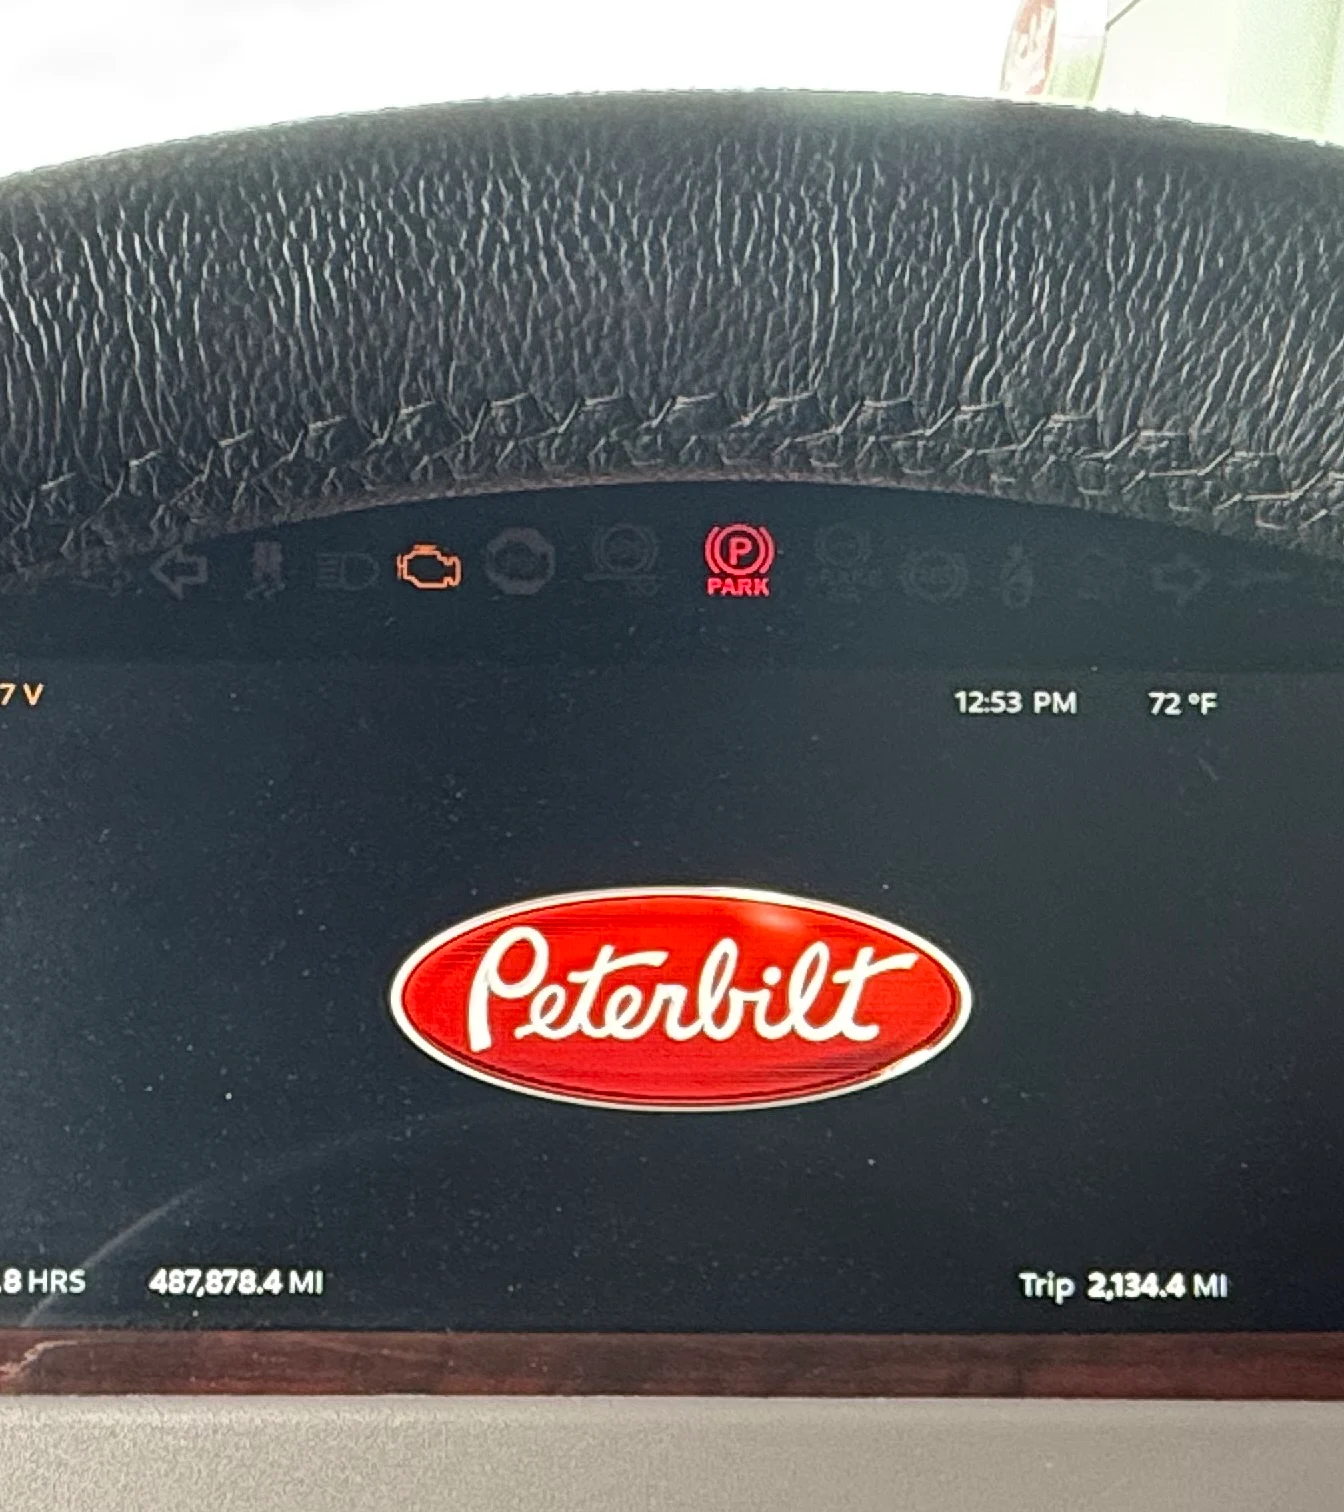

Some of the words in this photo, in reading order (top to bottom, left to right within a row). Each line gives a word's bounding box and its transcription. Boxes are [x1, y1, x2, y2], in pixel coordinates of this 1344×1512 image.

[707, 578, 769, 597] PARK
[23, 682, 44, 706] V
[955, 690, 1023, 714] 12:53
[1033, 691, 1077, 714] PM
[1148, 692, 1182, 716] 72
[1188, 692, 1218, 716] °F
[467, 926, 918, 1053] Peterbilt
[28, 1268, 86, 1294] HRS
[148, 1267, 283, 1298] 487,878.4
[288, 1269, 324, 1295] MI
[1018, 1270, 1076, 1305] Trip
[1087, 1271, 1186, 1301] 2,134.4
[1193, 1272, 1228, 1298] MI
